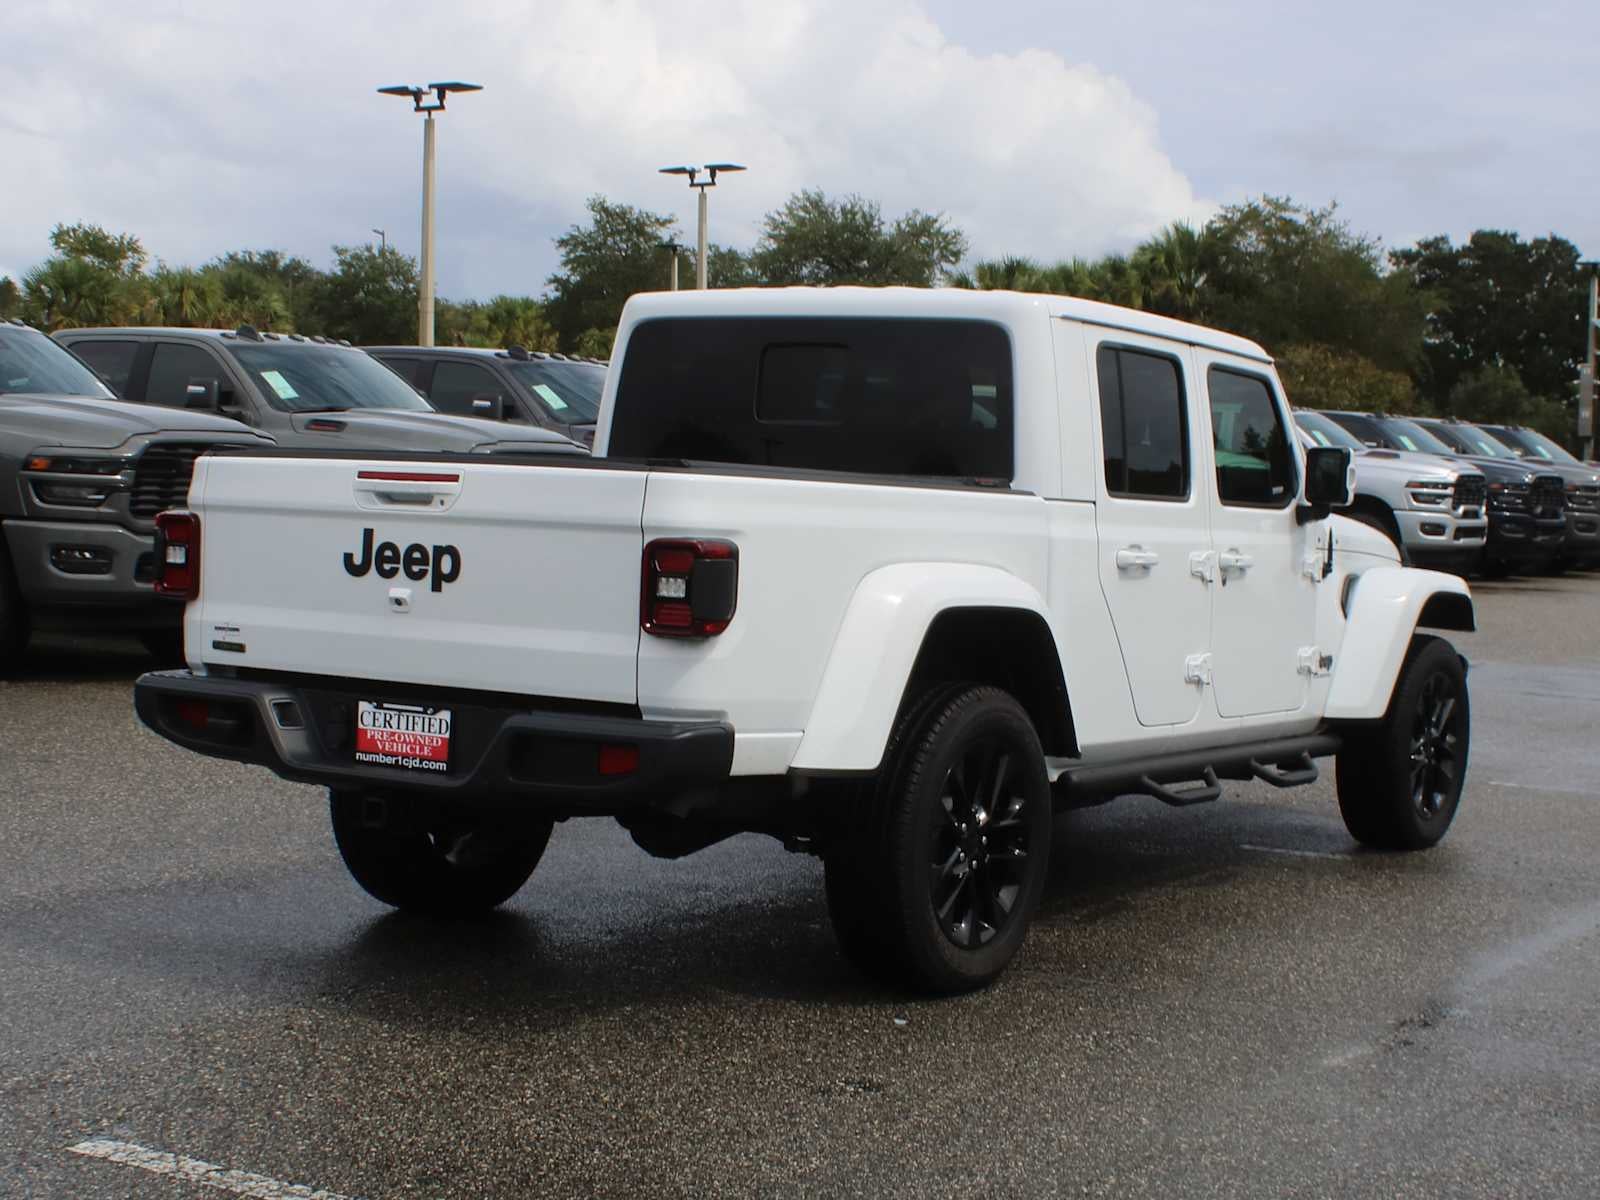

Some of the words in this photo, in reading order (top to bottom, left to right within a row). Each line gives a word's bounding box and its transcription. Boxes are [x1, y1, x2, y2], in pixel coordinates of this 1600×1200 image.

[343, 528, 461, 592] Jeep
[360, 711, 450, 735] CERTIFIED
[367, 730, 442, 747] PRE-OWNED
[376, 740, 432, 756] VEHICLE
[355, 752, 447, 771] number1cjd.com
